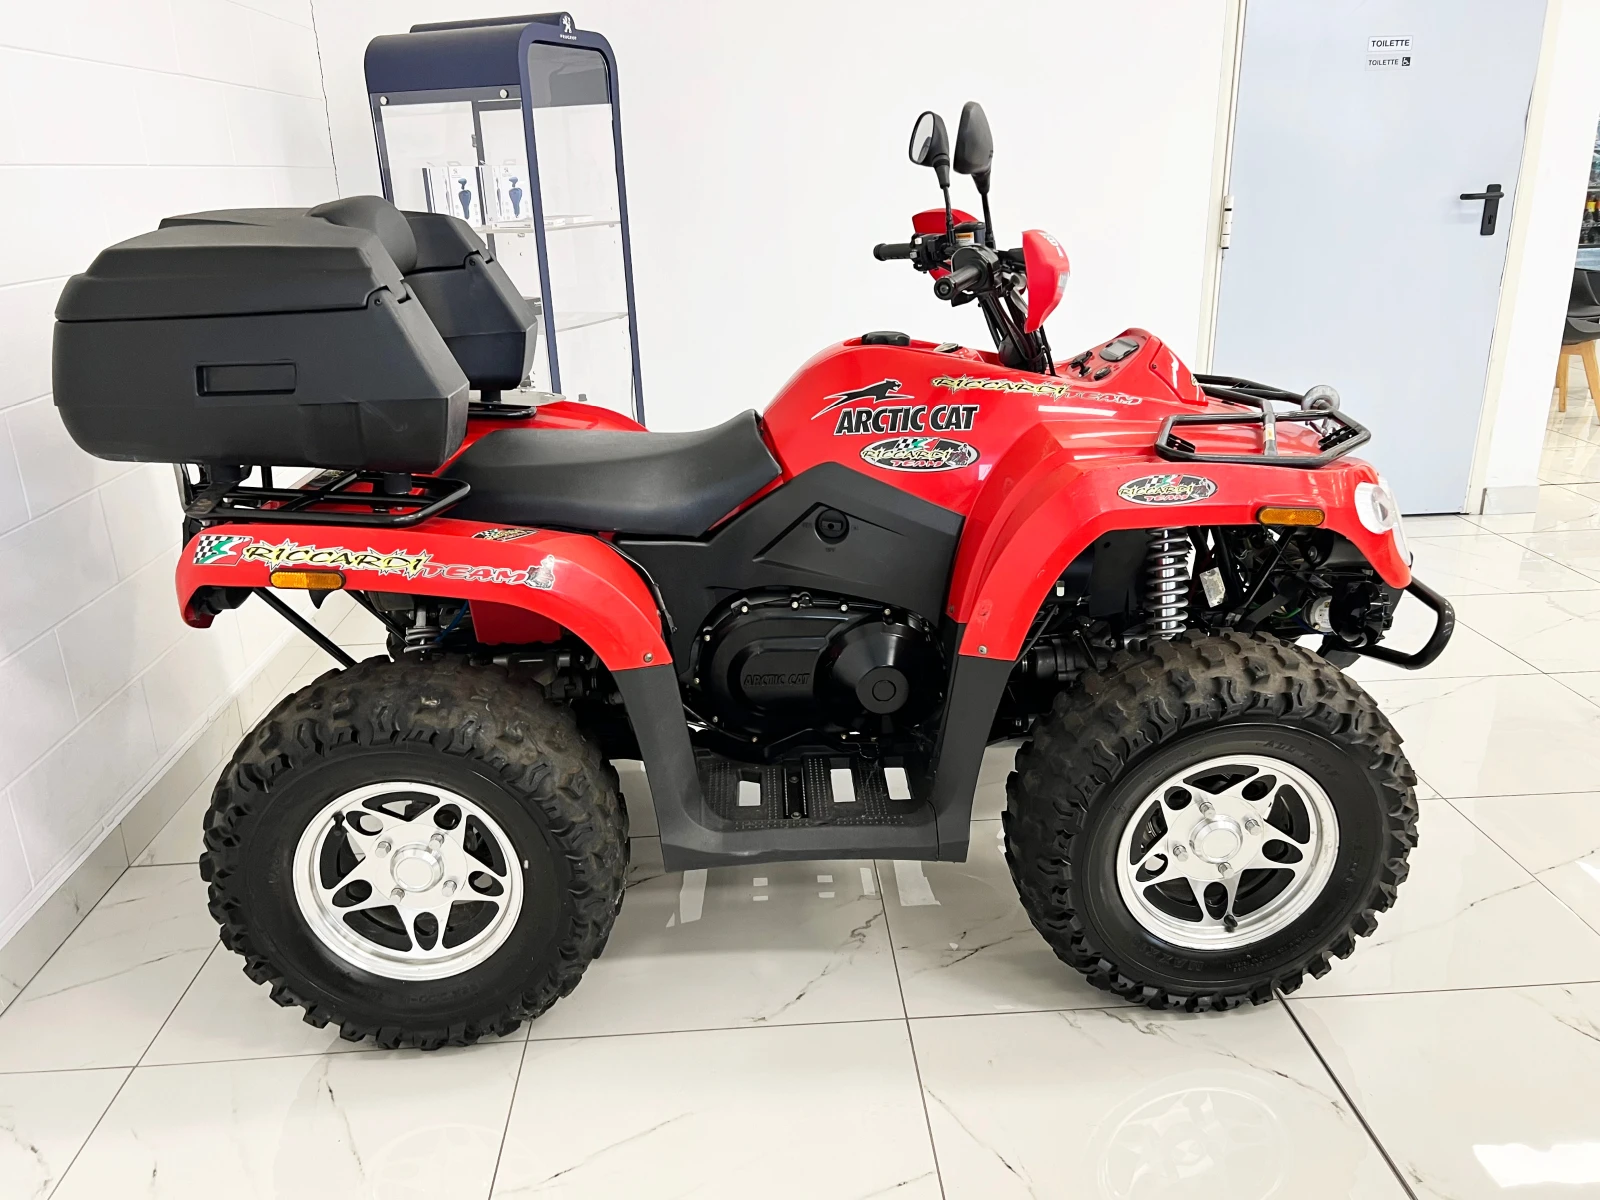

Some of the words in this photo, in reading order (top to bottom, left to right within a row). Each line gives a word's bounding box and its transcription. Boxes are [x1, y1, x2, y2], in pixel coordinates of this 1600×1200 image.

[1371, 39, 1410, 47] TOILETTE
[931, 376, 1068, 397] RICCARDI
[834, 405, 927, 435] ARCTIC
[929, 404, 979, 431] CAT
[861, 447, 953, 463] RICCARDI
[1119, 484, 1194, 498] RICCARDI
[244, 542, 427, 575] RICCARDI
[420, 563, 528, 585] TEAM
[744, 674, 785, 686] ARCTIC
[788, 673, 811, 684] CAT
